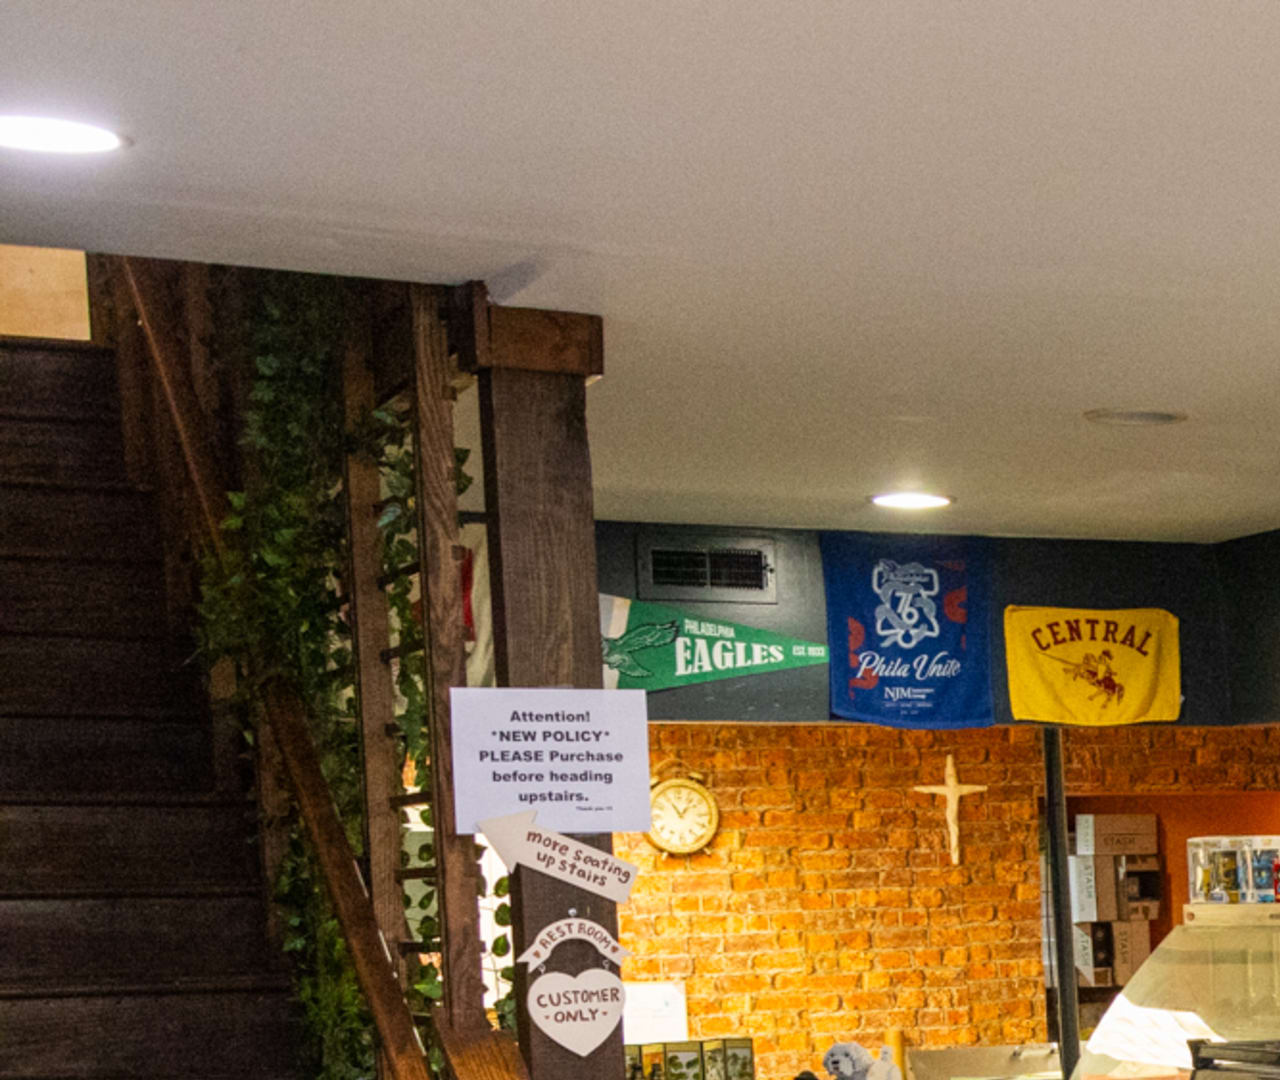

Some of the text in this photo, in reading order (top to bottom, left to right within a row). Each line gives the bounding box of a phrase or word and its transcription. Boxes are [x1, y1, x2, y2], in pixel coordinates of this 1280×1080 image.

[684, 619, 735, 639] PHILADELPHIA
[1031, 619, 1152, 657] CENTRAL
[675, 636, 784, 677] EAGLES
[856, 651, 910, 678] Phila
[510, 710, 590, 723] Attention!
[479, 750, 623, 763] PLEASE Purchase
[492, 771, 613, 784] before heading
[518, 791, 589, 804] upstairs.
[526, 831, 569, 854] more
[1104, 837, 1136, 846] STASH
[537, 852, 607, 887] up stairs
[537, 987, 620, 1008] CUSTOMER
[554, 1011, 600, 1023] ONLY
